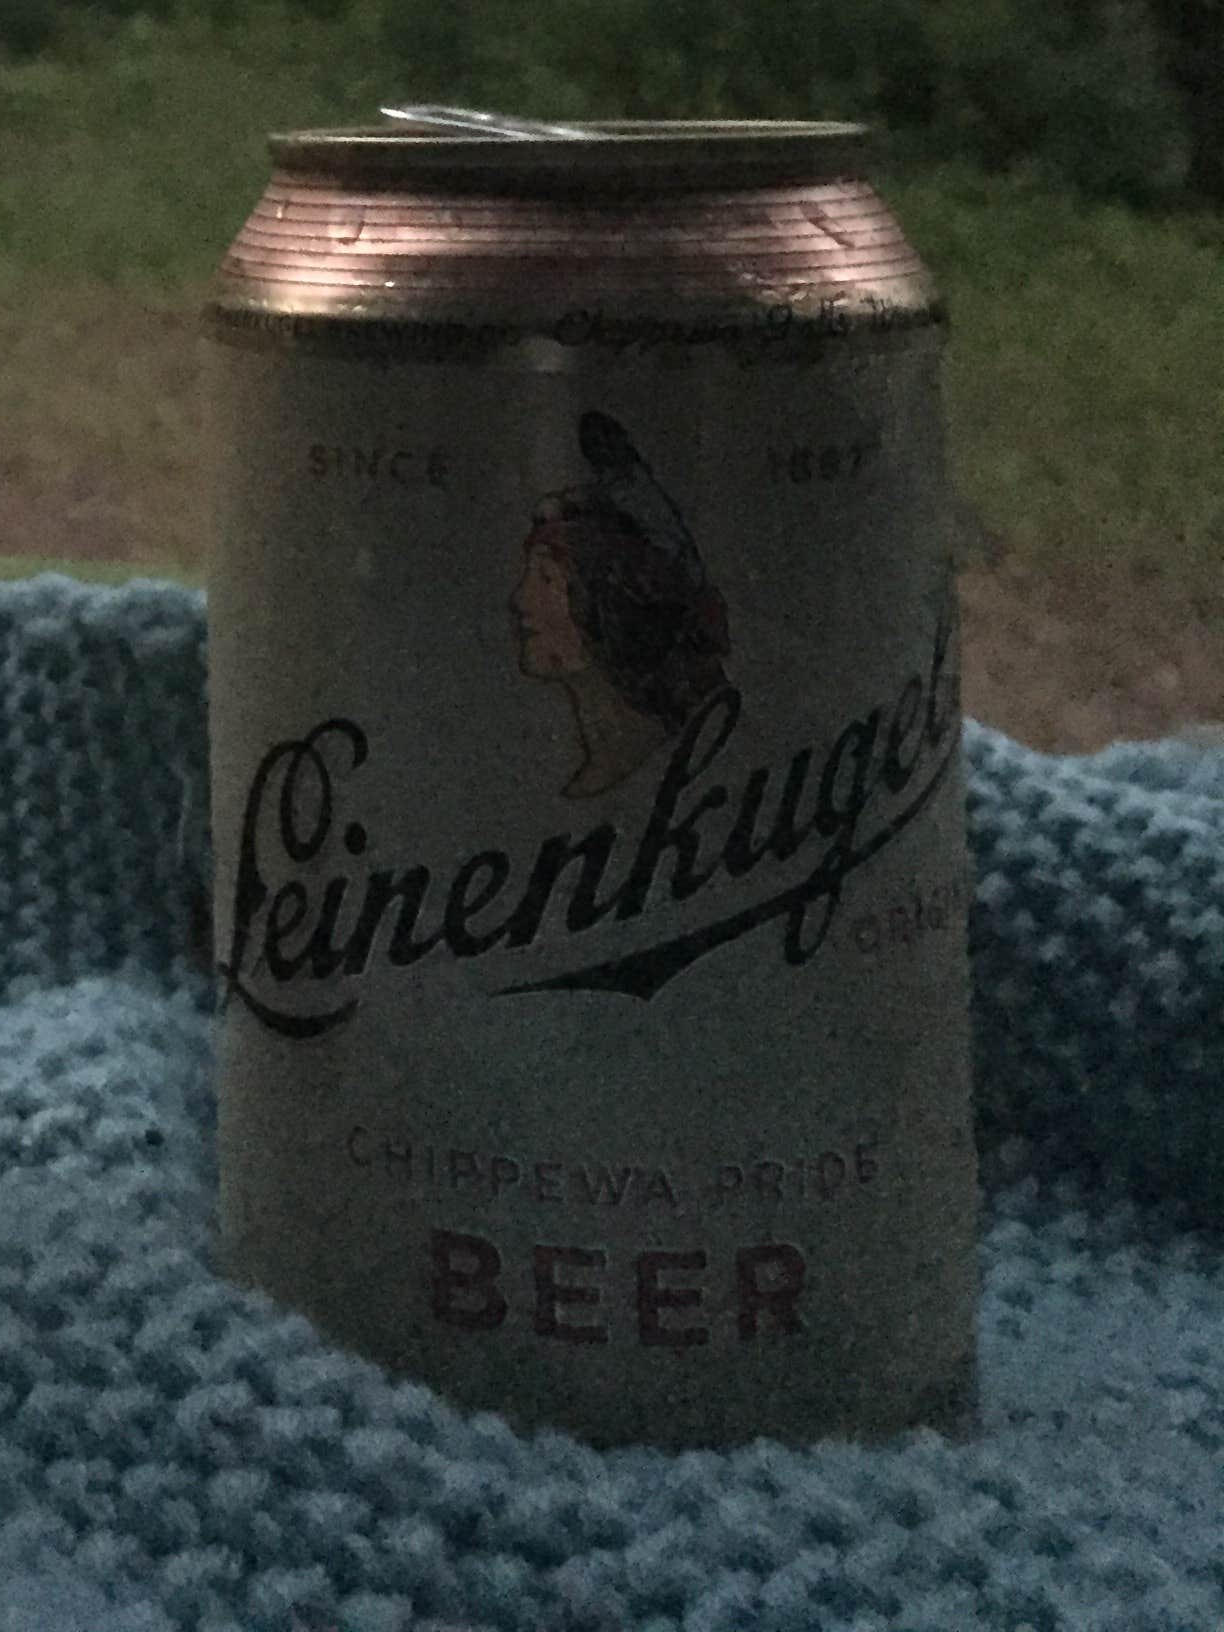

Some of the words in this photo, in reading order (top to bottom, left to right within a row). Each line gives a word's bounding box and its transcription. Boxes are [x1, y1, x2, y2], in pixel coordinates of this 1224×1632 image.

[306, 443, 449, 488] SINCE
[345, 1124, 679, 1207] CHIPPEWA
[709, 1130, 883, 1205] PRIDE
[429, 1227, 807, 1347] BEER
